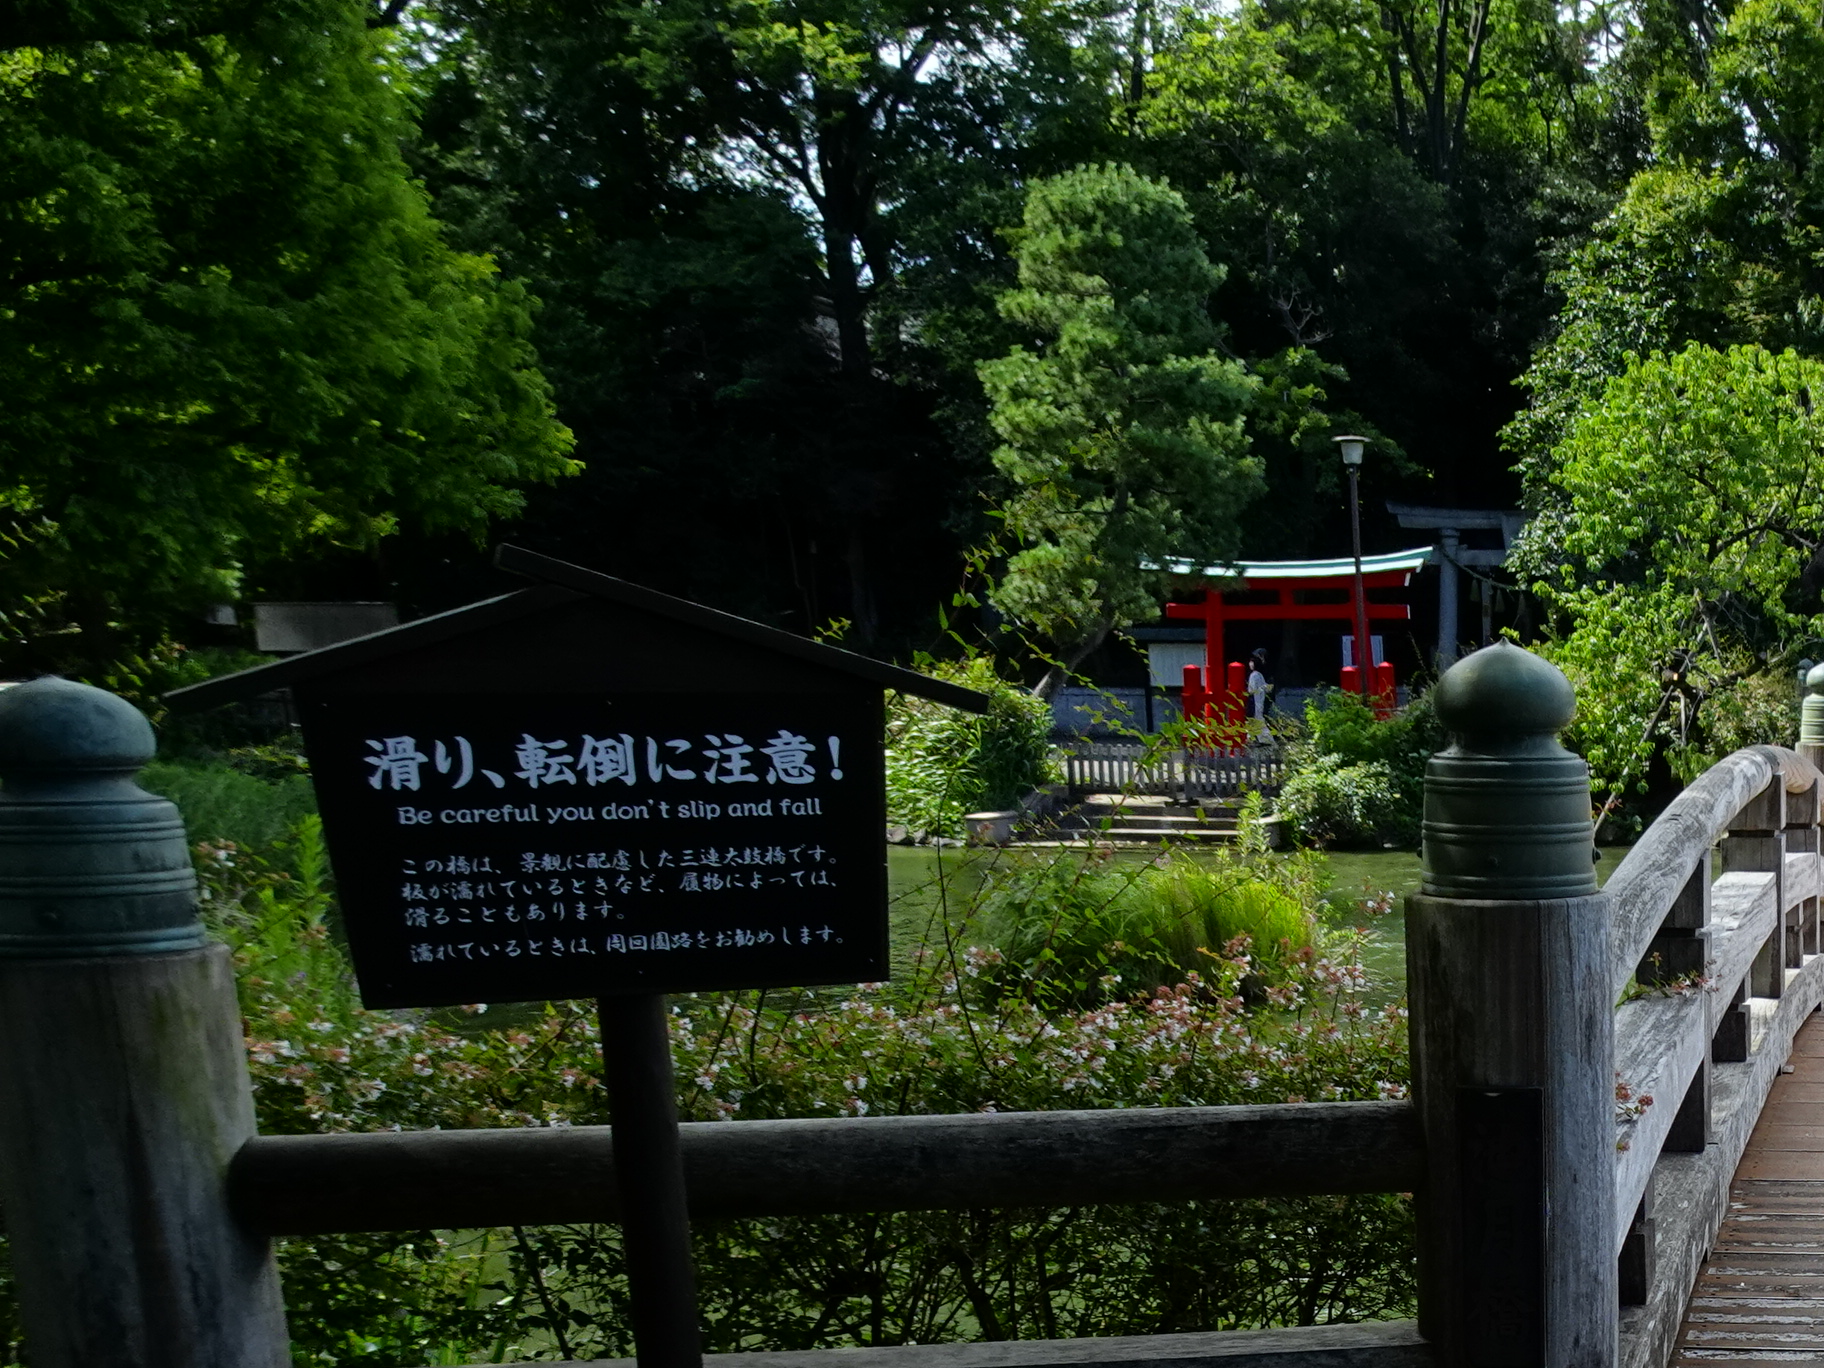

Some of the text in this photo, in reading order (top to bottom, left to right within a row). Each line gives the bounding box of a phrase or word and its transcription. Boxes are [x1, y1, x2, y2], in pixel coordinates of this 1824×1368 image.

[363, 730, 843, 791] 滑り、転倒に注意!
[397, 798, 823, 825] Be careful you don't slip and fall
[405, 901, 624, 928] 滑ることもあります。
